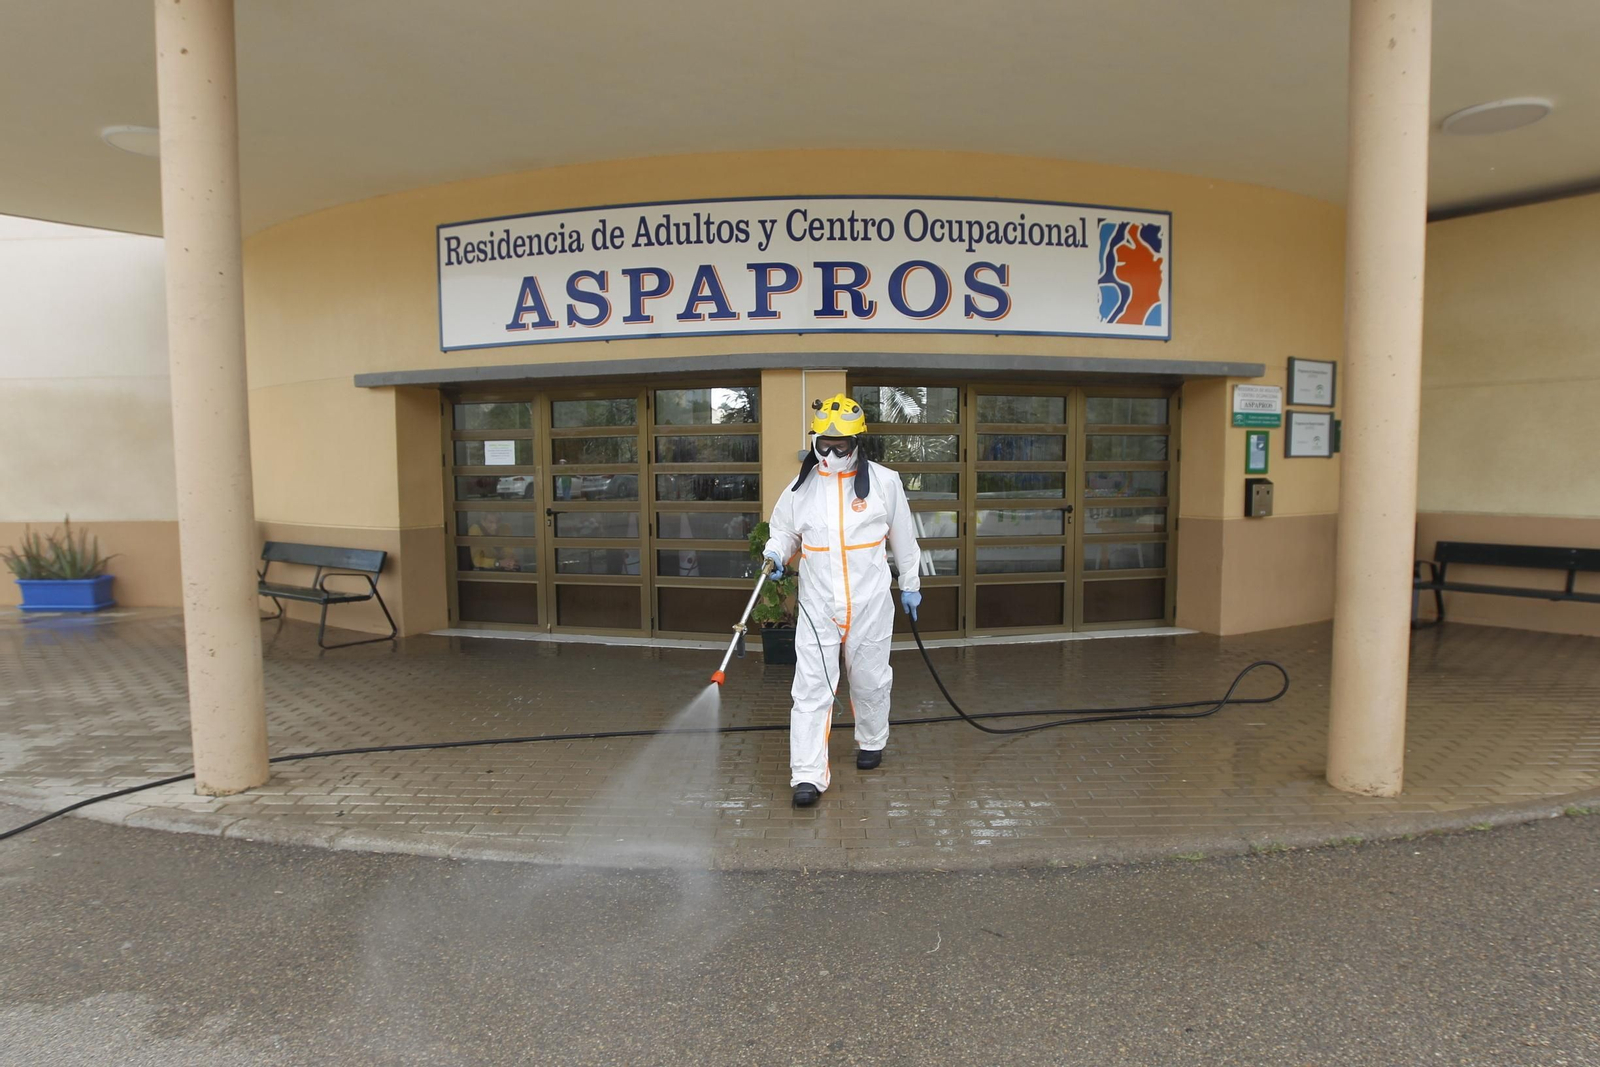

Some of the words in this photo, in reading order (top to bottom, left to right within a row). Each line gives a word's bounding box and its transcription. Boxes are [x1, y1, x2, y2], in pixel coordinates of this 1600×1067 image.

[444, 222, 584, 266] Residencia
[591, 219, 625, 250] de
[632, 212, 750, 248] Adultos
[757, 217, 778, 252] y
[785, 208, 895, 242] Centro
[903, 208, 1089, 253] Ocupacional
[505, 259, 1012, 333] ASPAPROS
